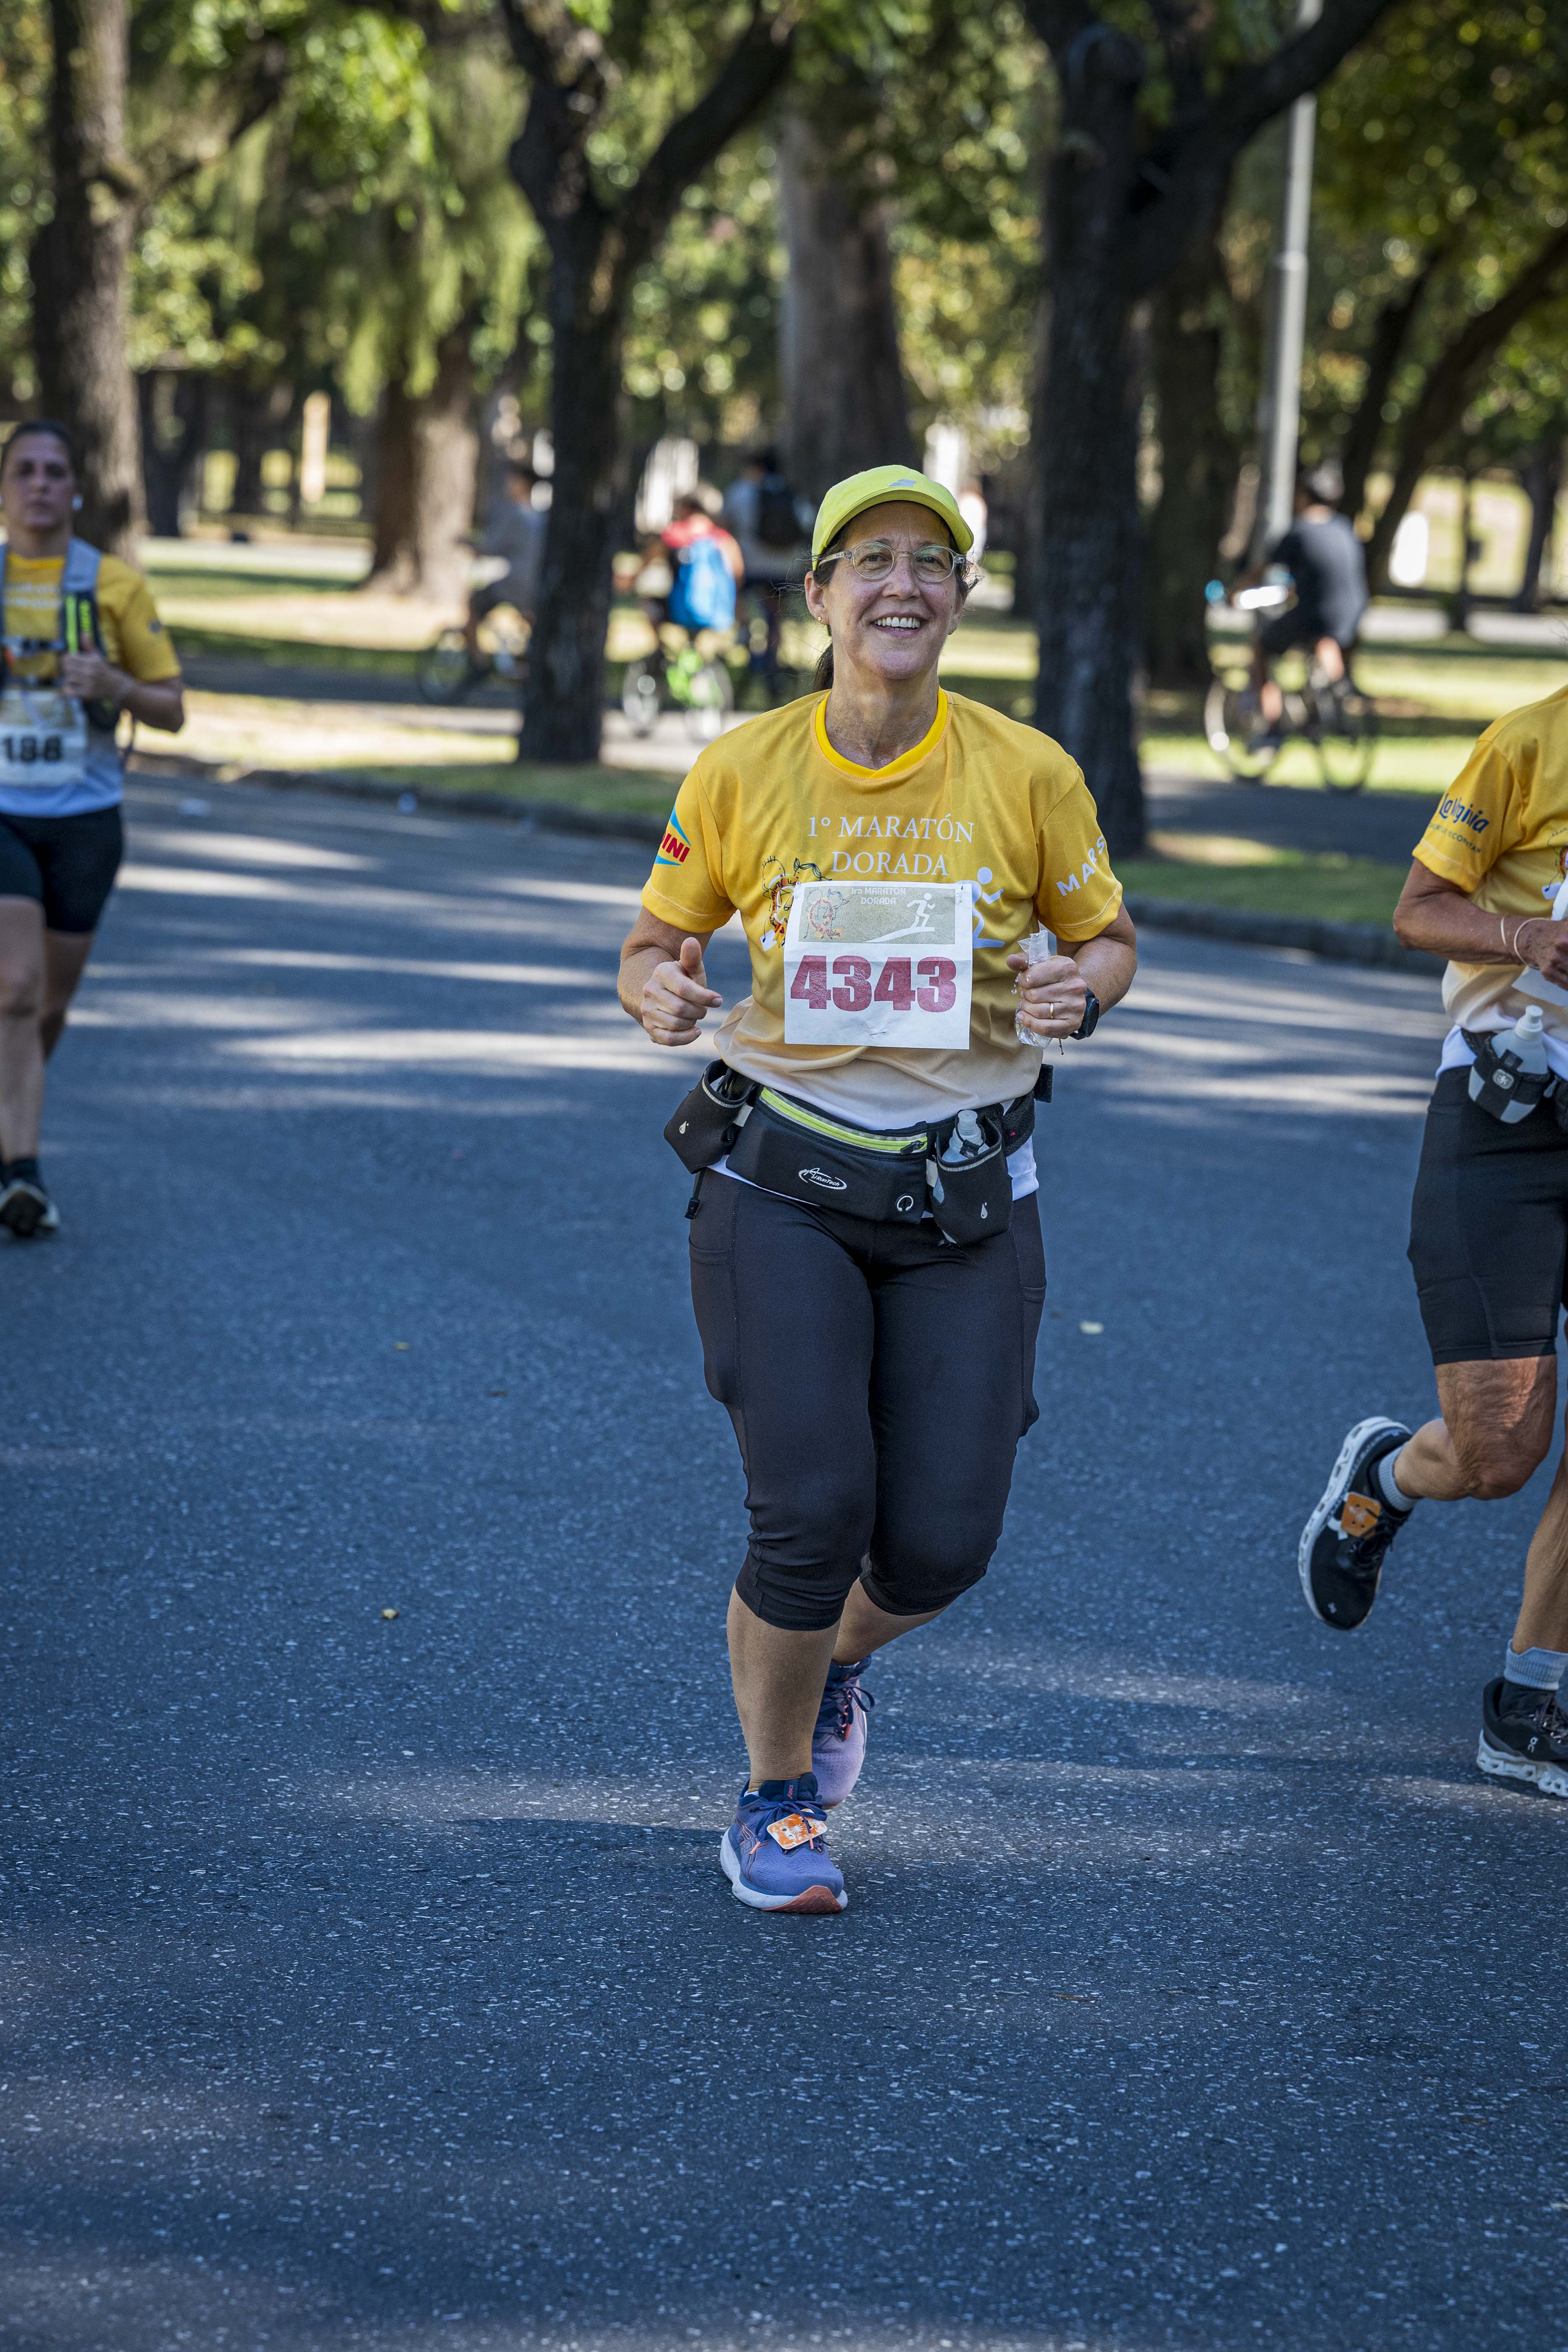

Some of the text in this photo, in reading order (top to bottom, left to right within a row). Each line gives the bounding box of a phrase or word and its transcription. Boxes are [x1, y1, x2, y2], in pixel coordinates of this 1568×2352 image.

[1439, 793, 1453, 819] La
[838, 813, 974, 843] MARATÓN
[661, 831, 690, 862] INI
[830, 851, 949, 876] DORADA
[1056, 835, 1105, 896] MARS
[861, 896, 896, 905] DORADA
[865, 887, 906, 896] MARATON
[791, 955, 957, 1013] 4343
